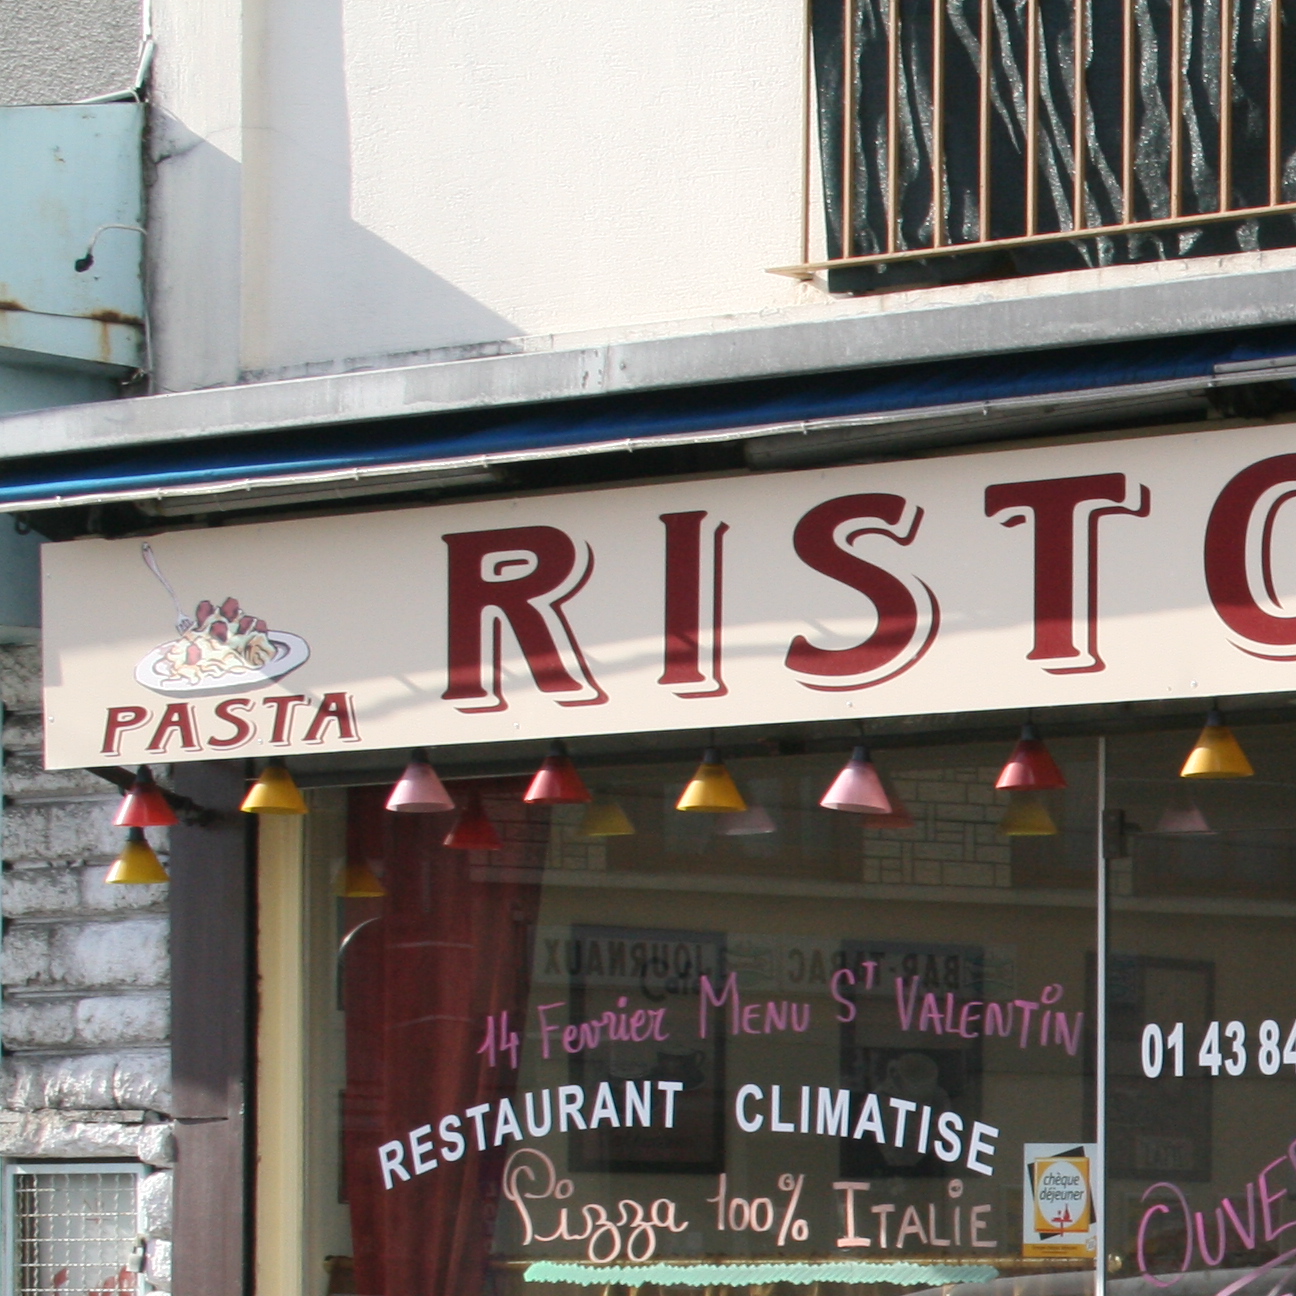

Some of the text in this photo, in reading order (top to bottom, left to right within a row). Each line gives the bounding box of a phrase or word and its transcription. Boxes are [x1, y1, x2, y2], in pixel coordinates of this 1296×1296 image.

[100, 690, 362, 757] PASTA
[377, 1080, 1001, 1191] RESTAURANT CLIMATISE
[707, 1172, 810, 1248] 100%
[1039, 1186, 1085, 1203] déjeuner
[1043, 1171, 1080, 1188] chèque
